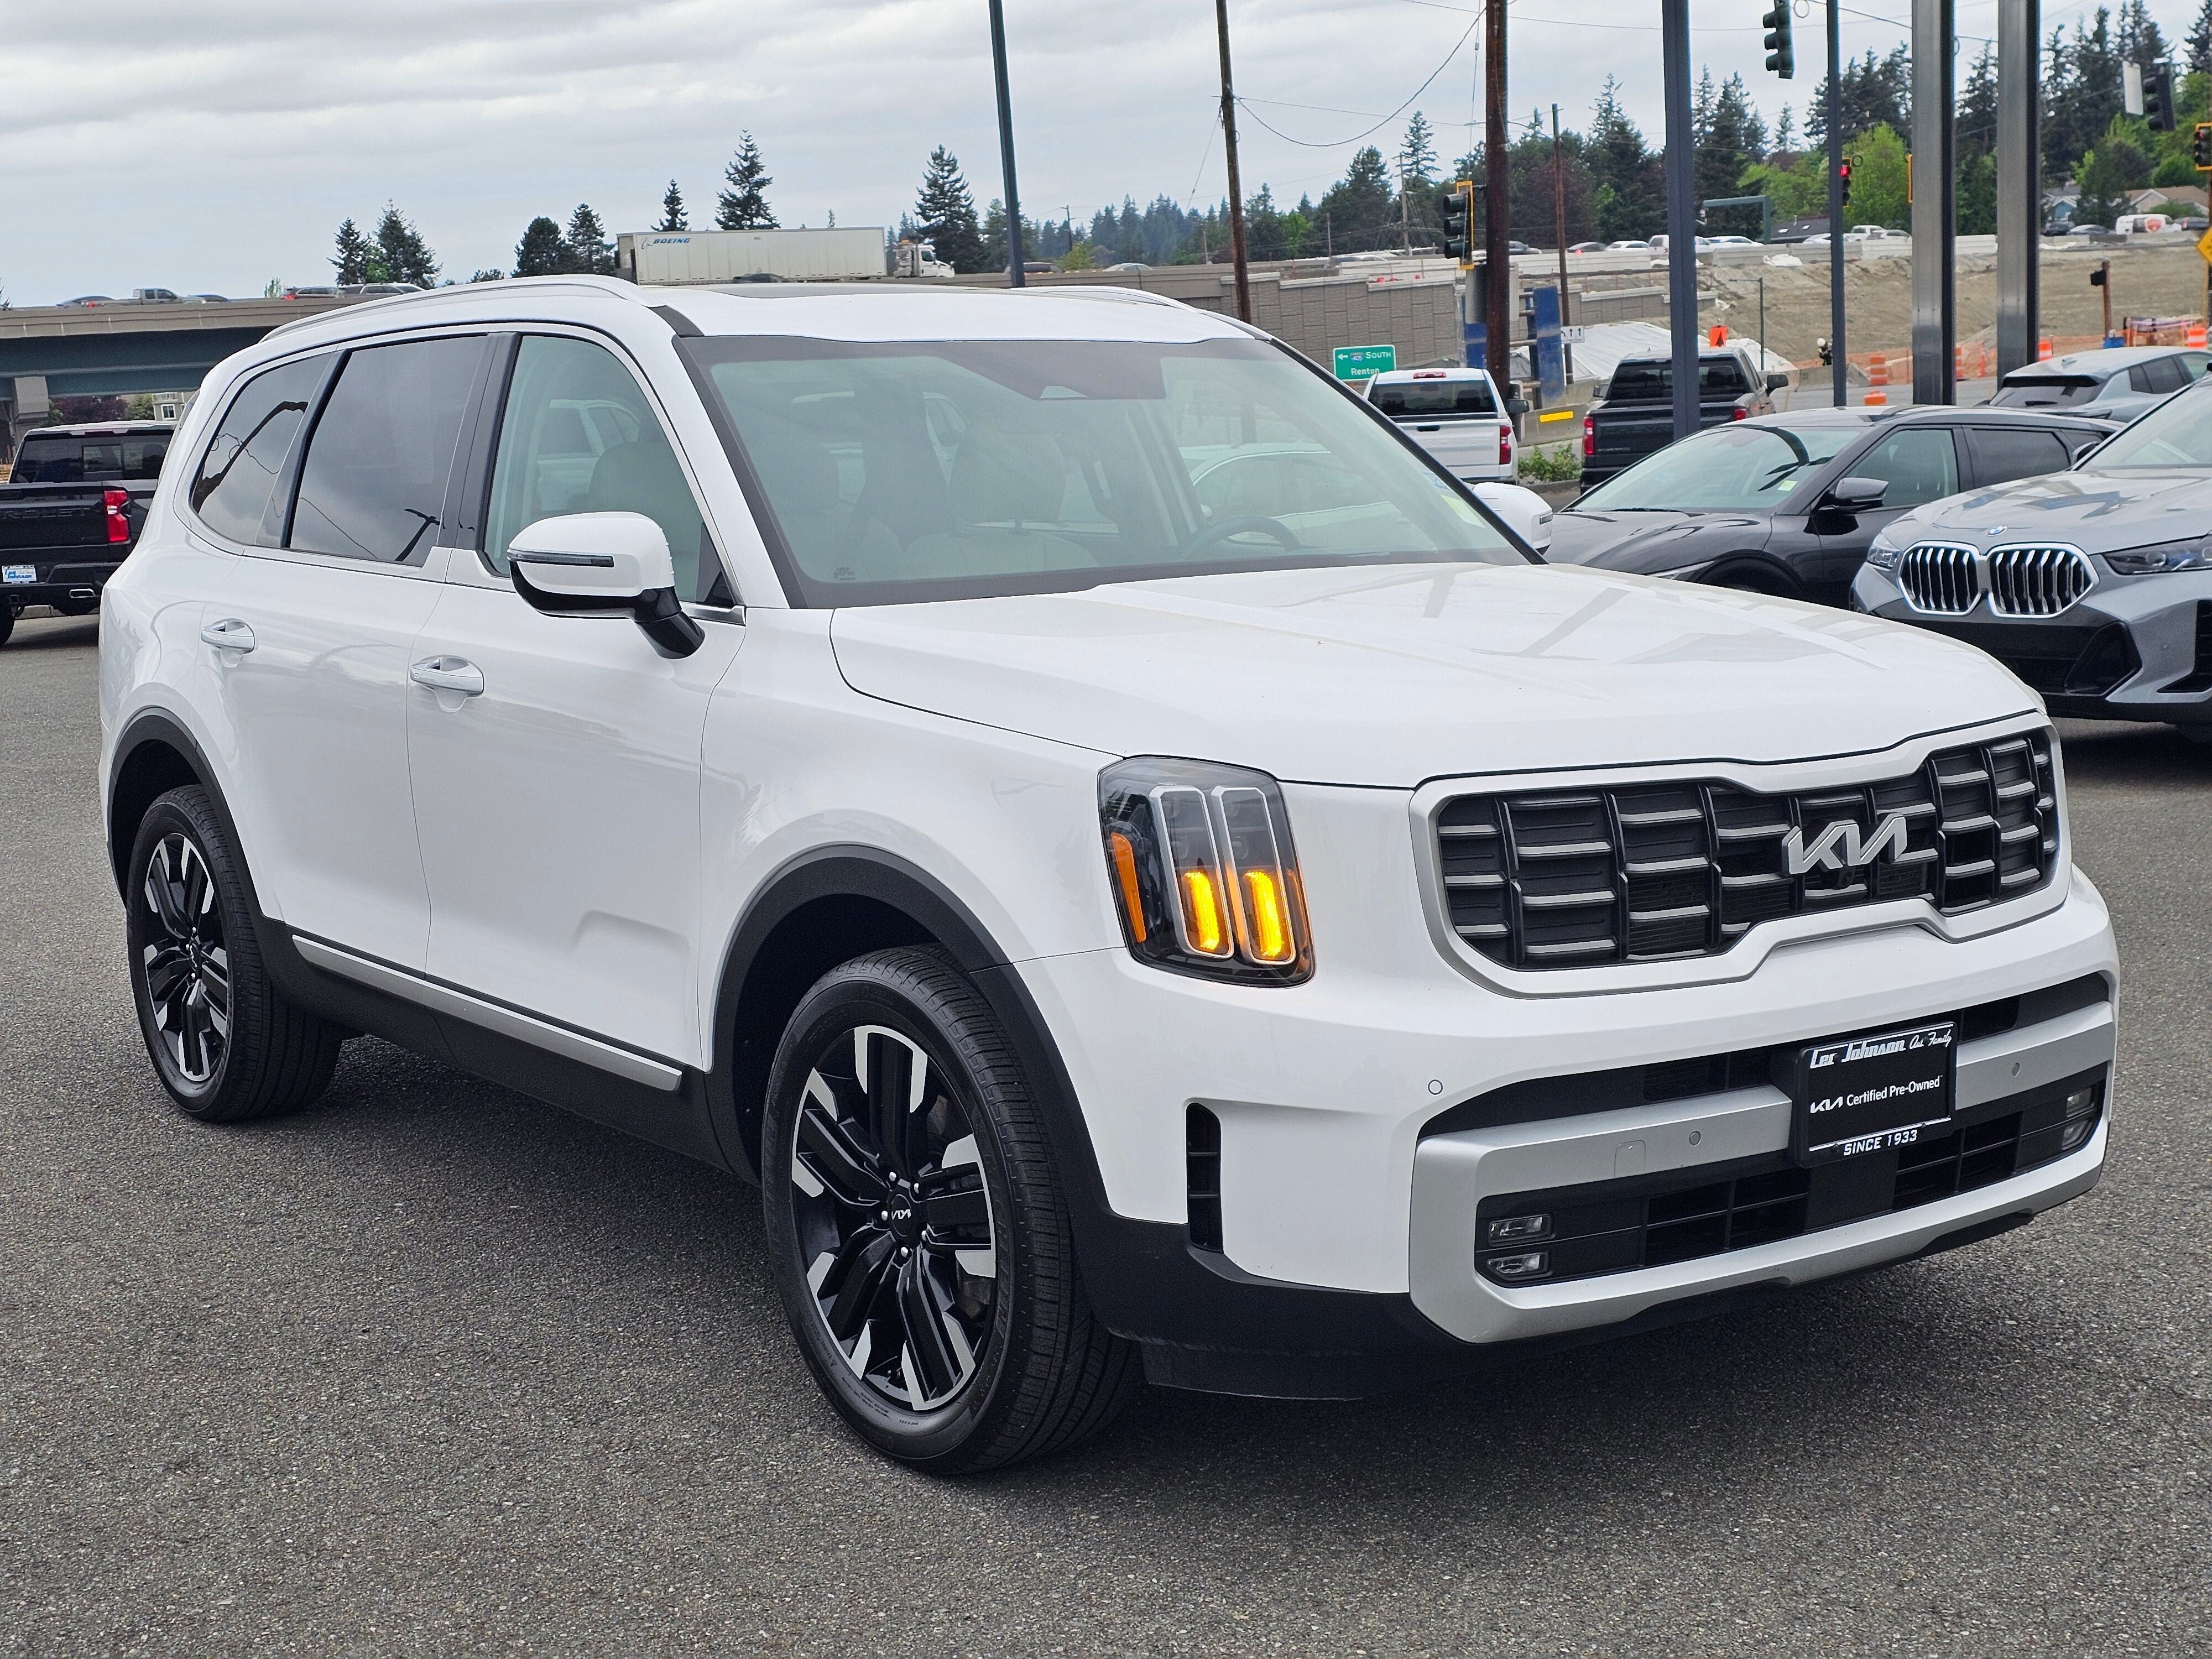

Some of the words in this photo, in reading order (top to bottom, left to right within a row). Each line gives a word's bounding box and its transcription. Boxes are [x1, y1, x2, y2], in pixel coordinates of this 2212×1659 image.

[1783, 812, 1907, 875] KIA
[1841, 1040, 1906, 1062] Johnson
[1928, 1029, 1952, 1047] Family
[1810, 1096, 1843, 1113] KIA
[1846, 1087, 1887, 1106] Certified
[1889, 1075, 1940, 1098] Pre-Owned
[1843, 1136, 1882, 1156] SINCE
[1887, 1129, 1918, 1146] 1933
[891, 1208, 911, 1220] KIA
